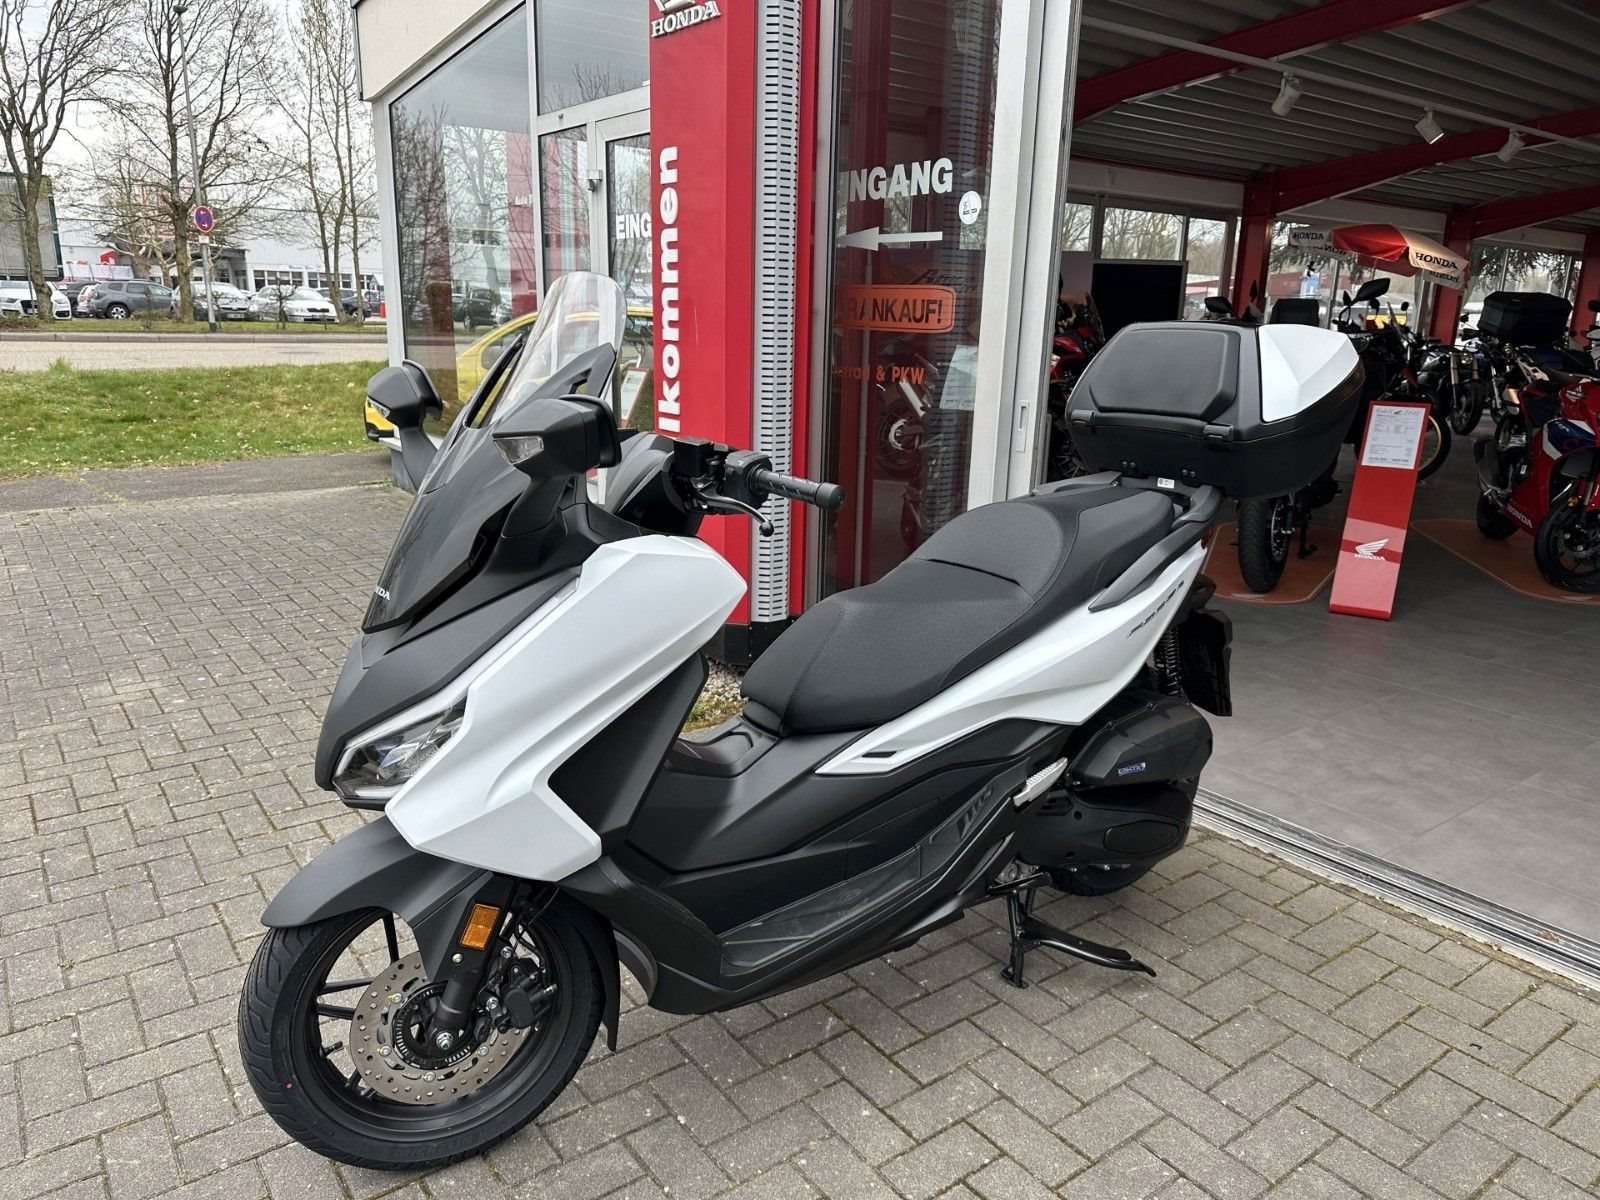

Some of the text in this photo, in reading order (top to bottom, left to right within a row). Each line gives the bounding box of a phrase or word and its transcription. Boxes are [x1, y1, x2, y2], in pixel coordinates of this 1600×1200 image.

[651, 1, 721, 38] HONDA
[1415, 252, 1458, 270] HONDA
[892, 366, 925, 385] PKW
[1506, 503, 1533, 529] HONDA
[1354, 553, 1386, 561] HONDA
